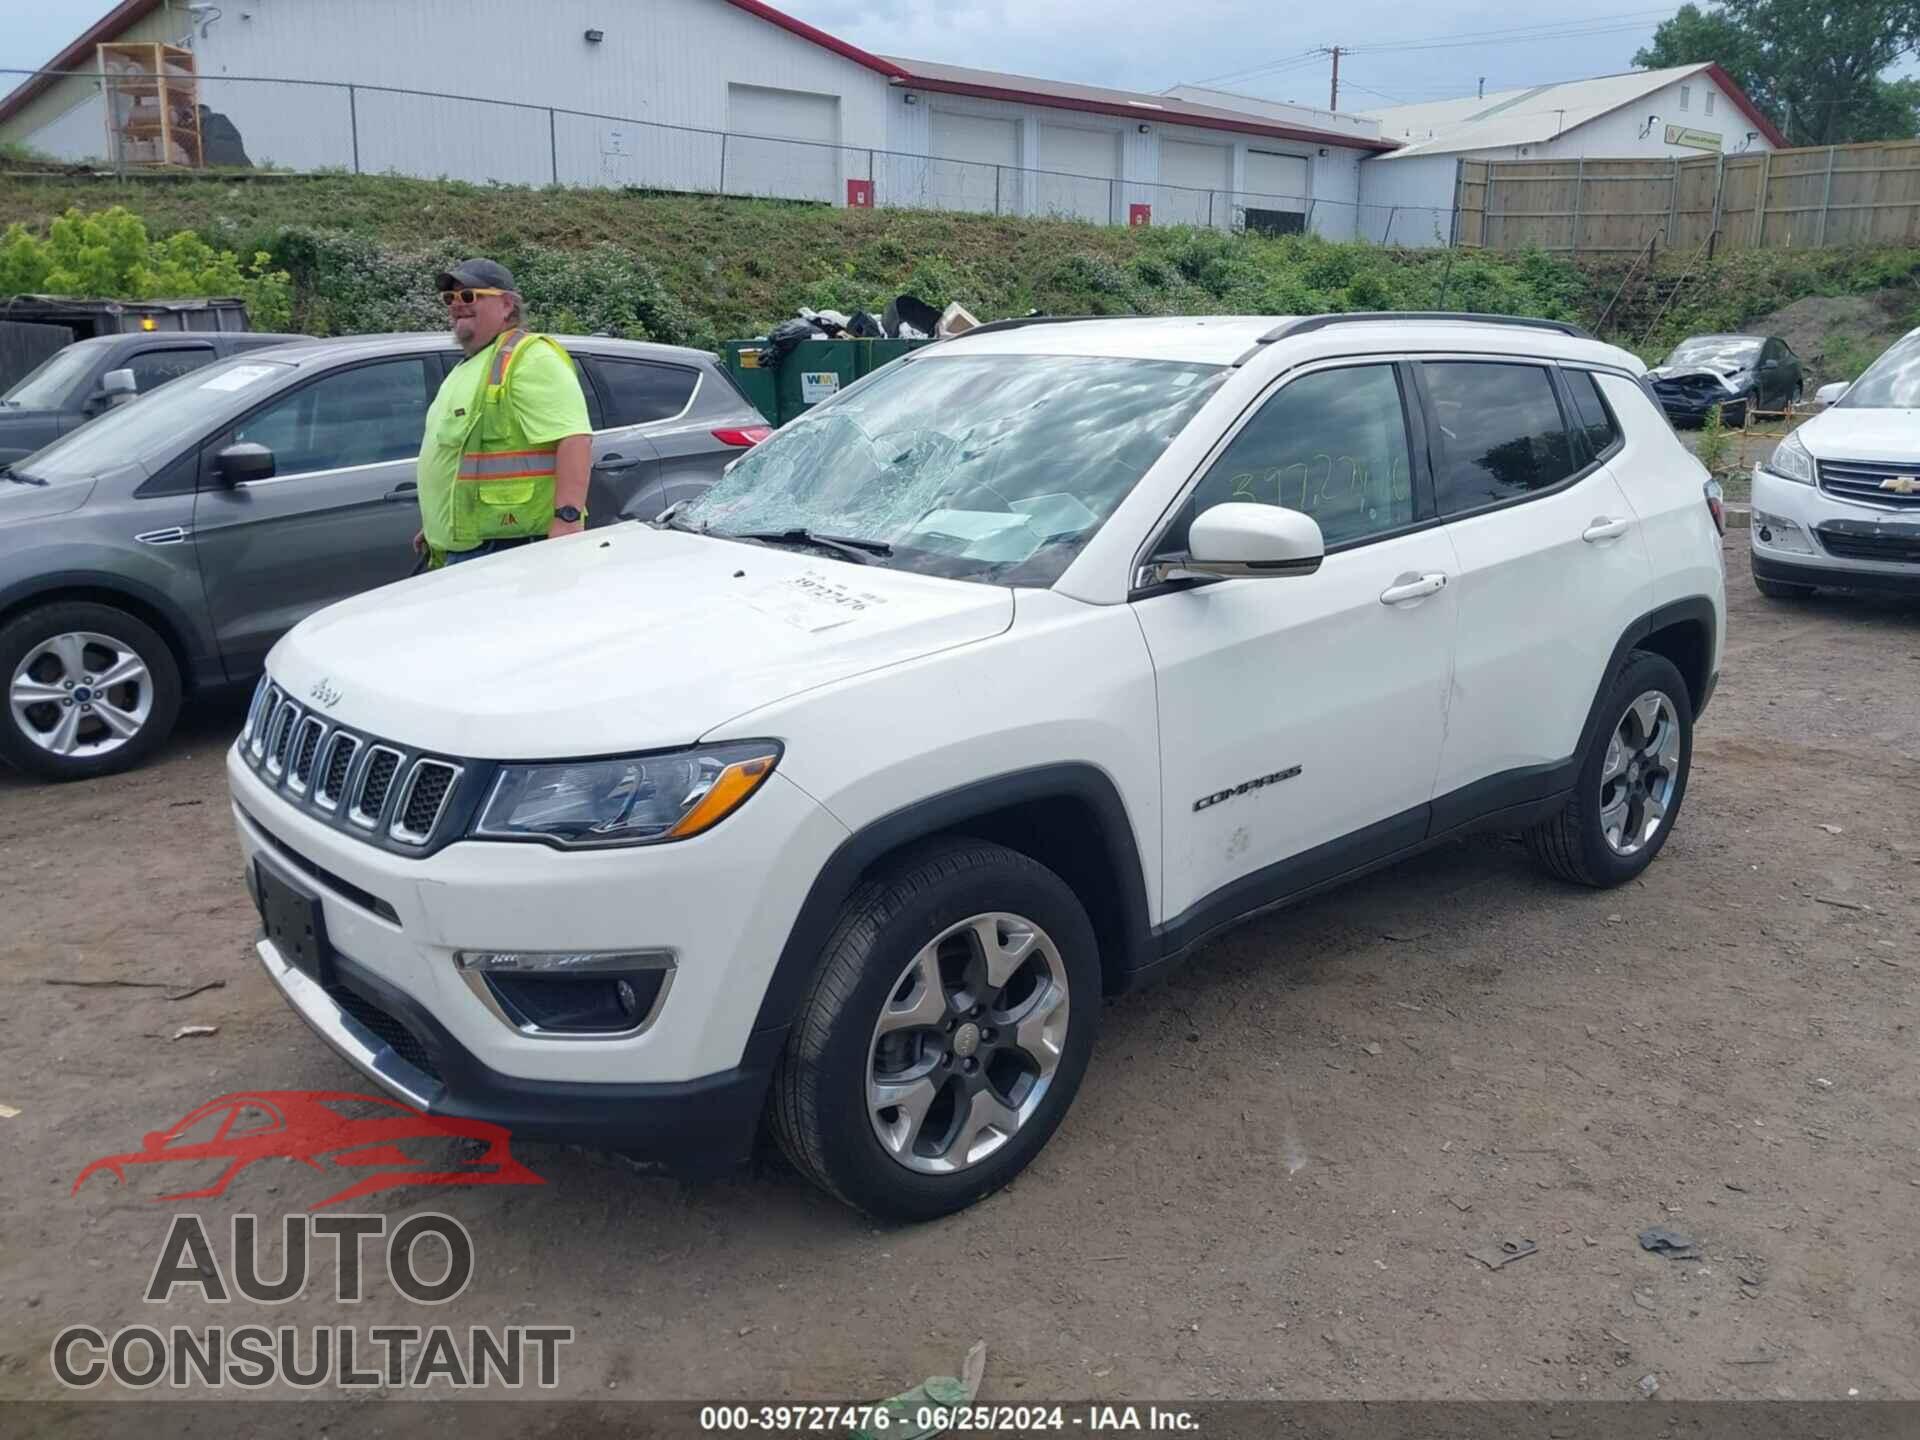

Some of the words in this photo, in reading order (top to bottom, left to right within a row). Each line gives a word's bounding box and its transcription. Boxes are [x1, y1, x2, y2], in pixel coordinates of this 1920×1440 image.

[807, 375, 833, 385] WM
[310, 677, 343, 709] Jeep
[1192, 763, 1303, 812] COMPASS
